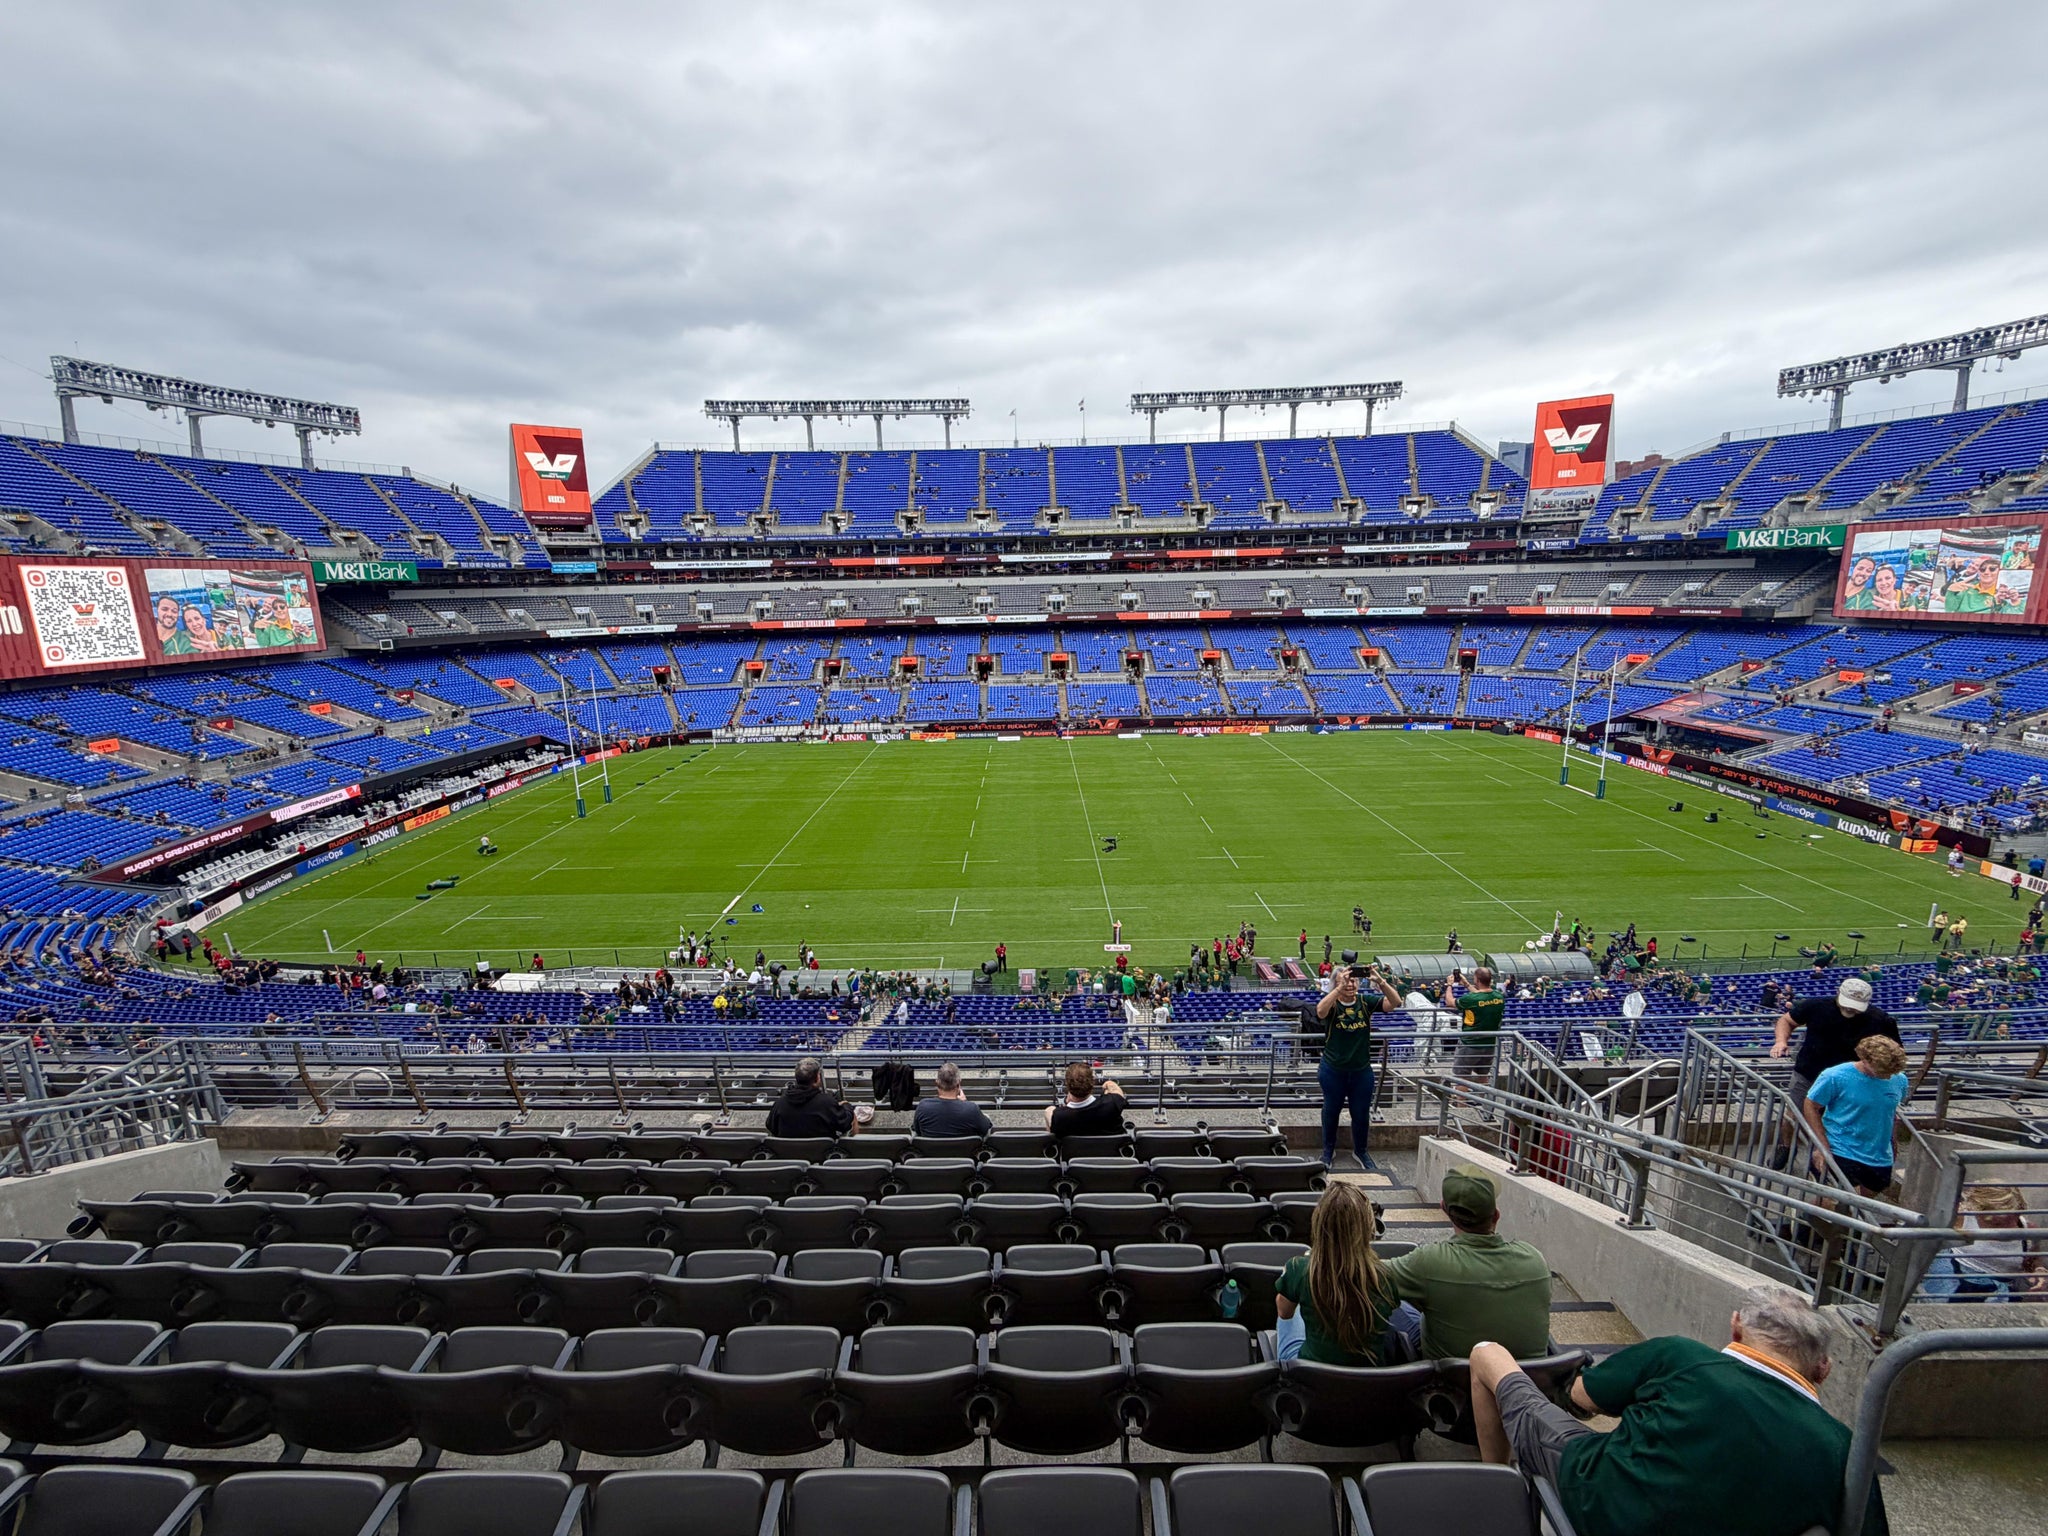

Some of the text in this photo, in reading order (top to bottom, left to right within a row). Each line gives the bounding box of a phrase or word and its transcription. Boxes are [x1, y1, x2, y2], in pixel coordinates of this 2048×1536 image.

[1736, 526, 1832, 548] M&T Bank
[322, 562, 410, 580] M&T Bank
[0, 605, 24, 635] TO
[1628, 757, 1666, 775] AIRLINK
[1668, 769, 1682, 778] CASTLE
[1700, 777, 1713, 787] MALT
[488, 779, 520, 799] AIRLINK
[301, 793, 343, 811] SPRINGBOKS
[1777, 800, 1816, 819] ActiveOps
[414, 810, 442, 827] DHL
[123, 825, 244, 875] RUGBY'S GREATEST RIVALRY
[307, 848, 344, 869] ActiveOps
[255, 872, 293, 893] Southern Sun
